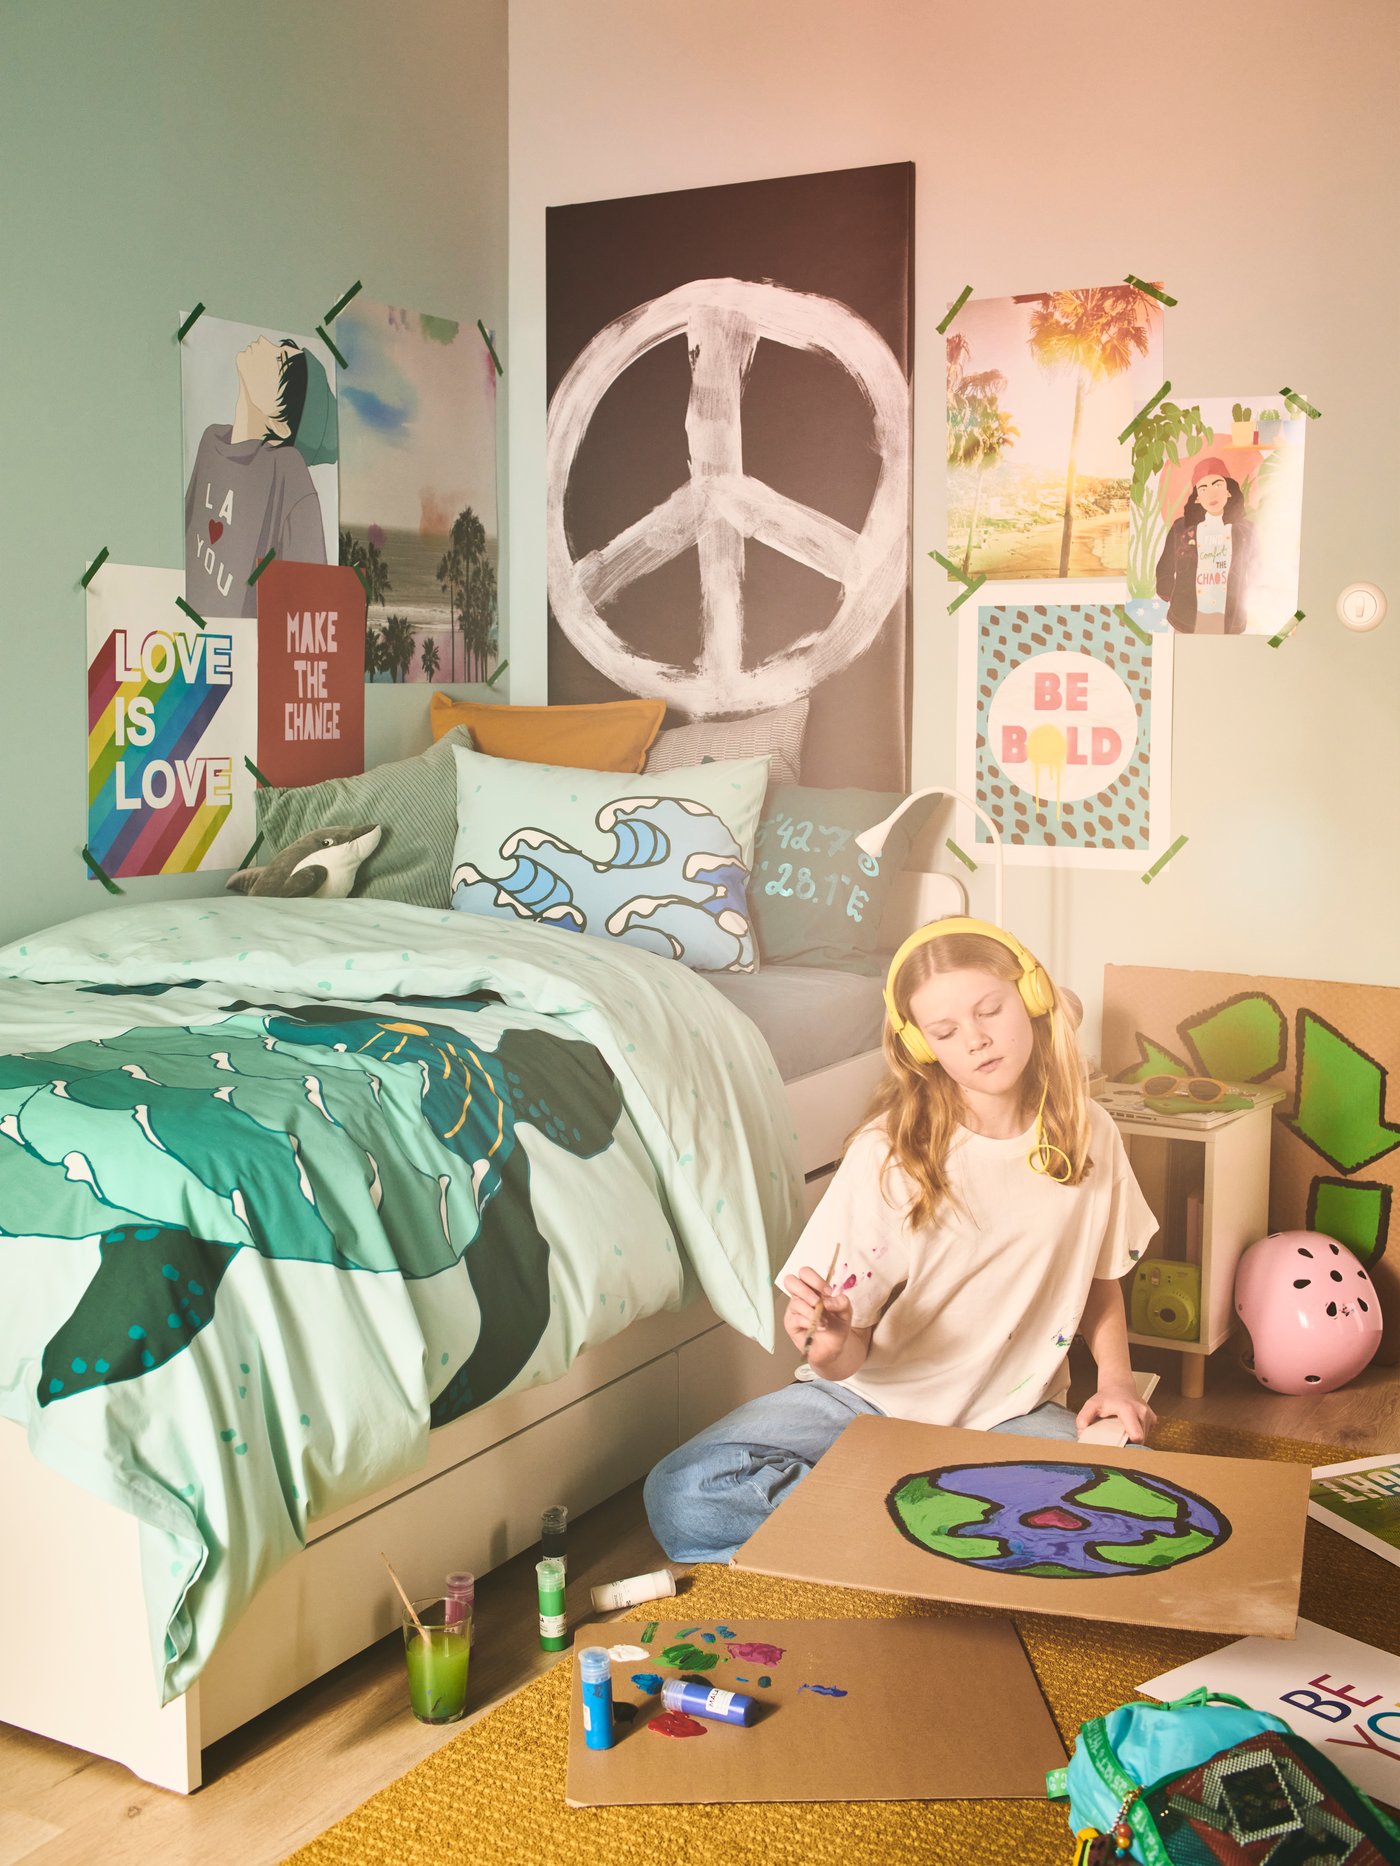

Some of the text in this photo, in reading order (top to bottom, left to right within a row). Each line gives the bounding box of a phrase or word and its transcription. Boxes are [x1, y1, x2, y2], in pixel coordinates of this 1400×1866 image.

[206, 483, 234, 525] LA
[197, 533, 234, 597] YOU
[1196, 571, 1227, 585] CHAOS
[1216, 560, 1227, 569] THE
[287, 611, 338, 653] MAKE
[115, 630, 232, 685] LOVE
[294, 660, 328, 698] THE
[1034, 672, 1089, 711] BE
[115, 696, 156, 747] IS
[284, 702, 340, 741] CHANGE
[115, 758, 232, 811] LOVE
[1278, 1673, 1384, 1724] BE
